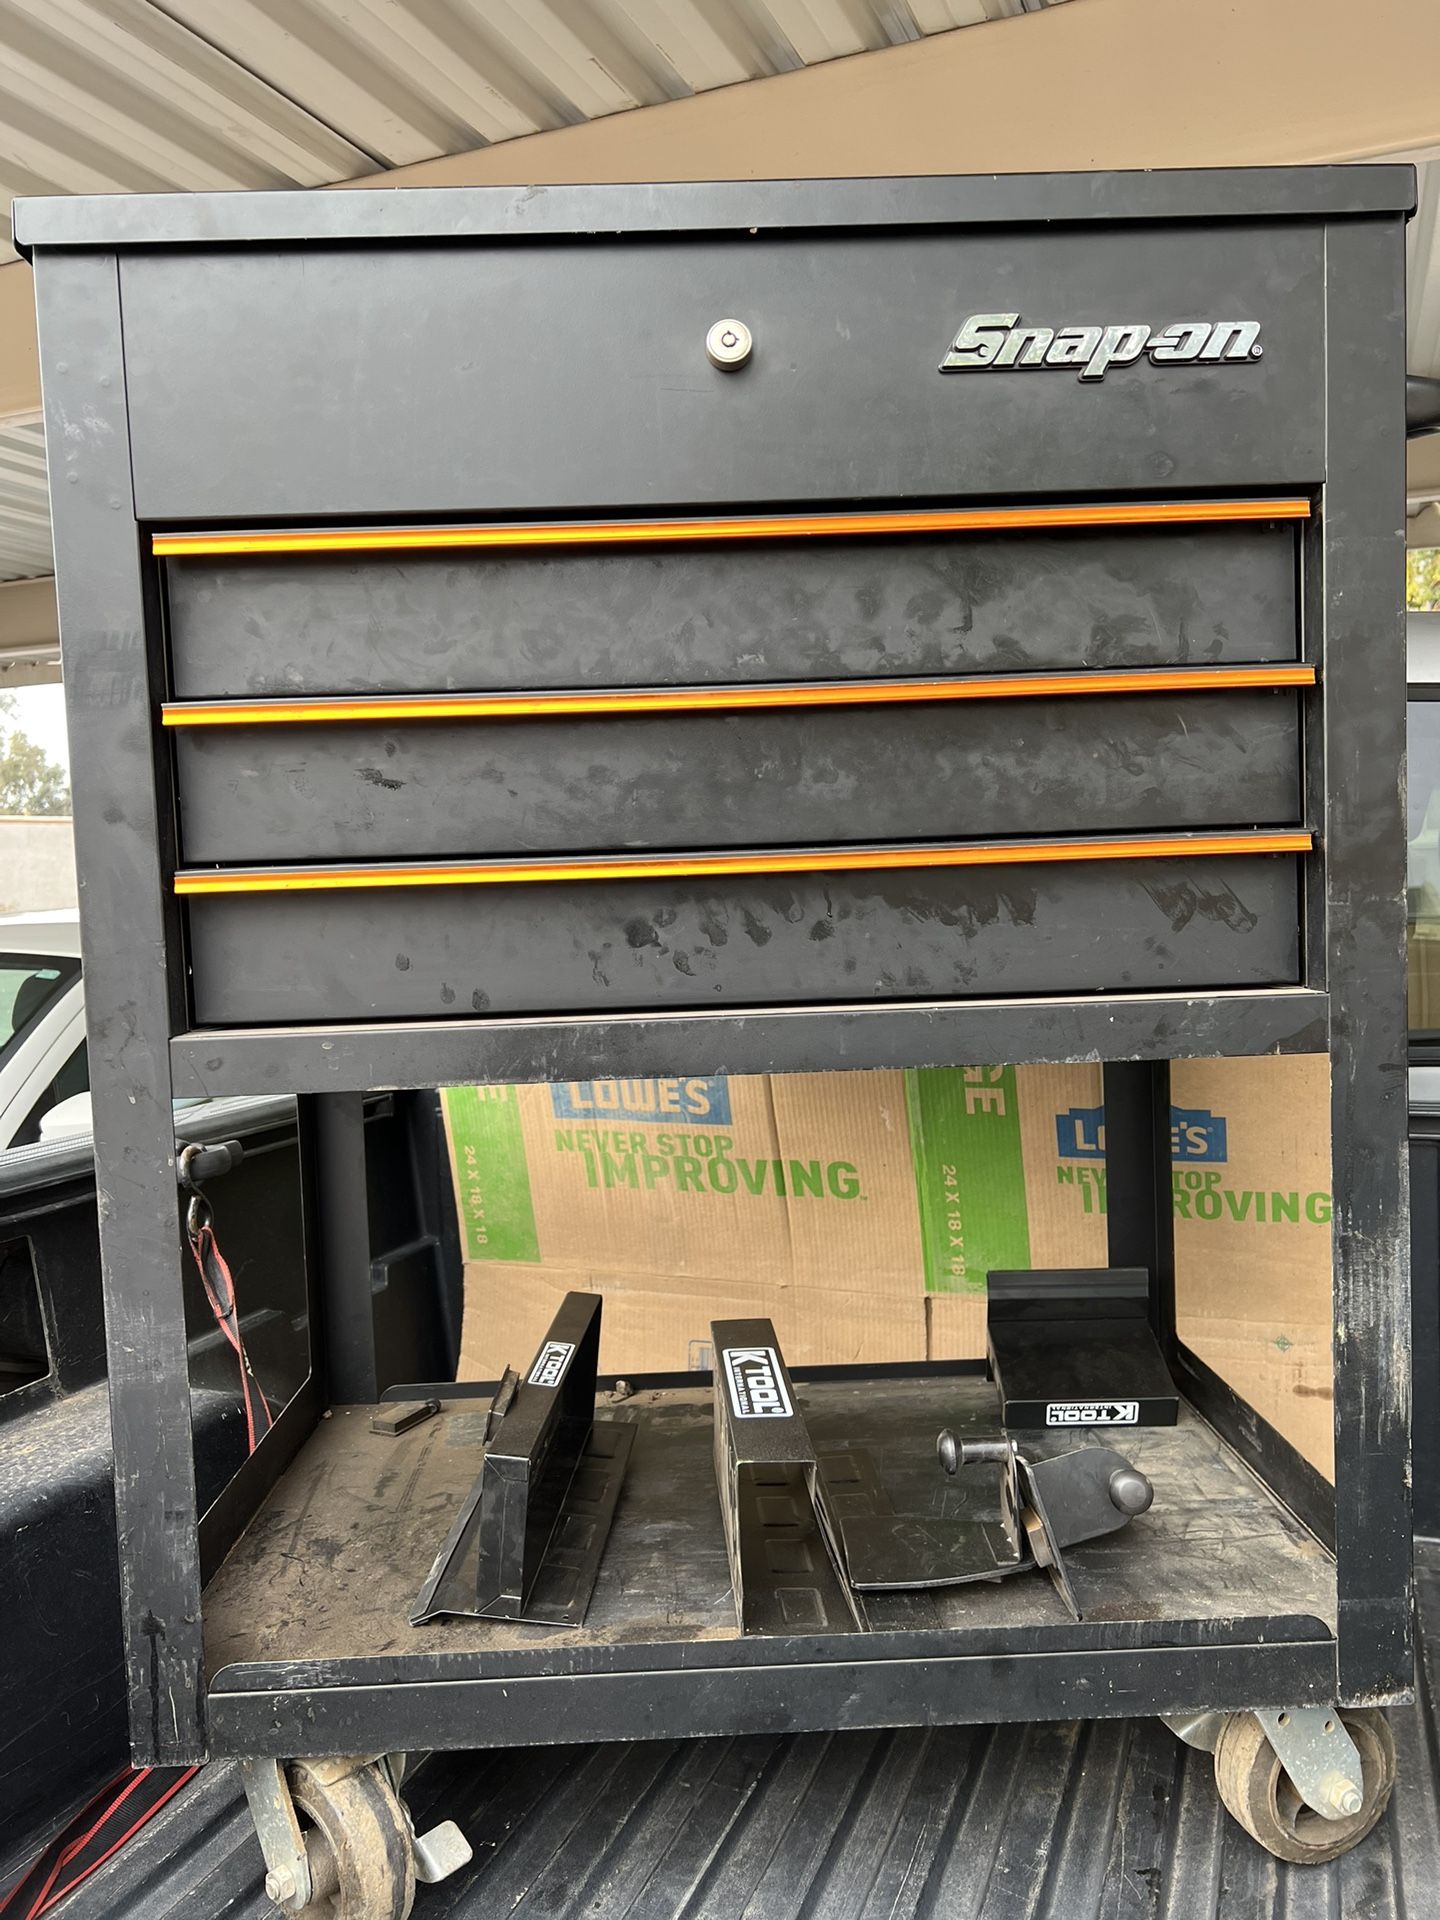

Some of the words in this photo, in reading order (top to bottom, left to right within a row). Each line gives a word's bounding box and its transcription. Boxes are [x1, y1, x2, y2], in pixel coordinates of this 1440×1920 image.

[939, 313, 1261, 380] Snap-on
[554, 1129, 647, 1154] NEVER
[656, 1133, 733, 1158] STOP
[464, 1145, 477, 1165] 24
[583, 1149, 861, 1200] IMPROVING
[942, 1164, 958, 1187] 24
[1172, 1171, 1222, 1191] TOP
[470, 1187, 482, 1207] 18
[947, 1210, 962, 1231] 18
[475, 1226, 488, 1244] 18
[951, 1255, 966, 1276] 18
